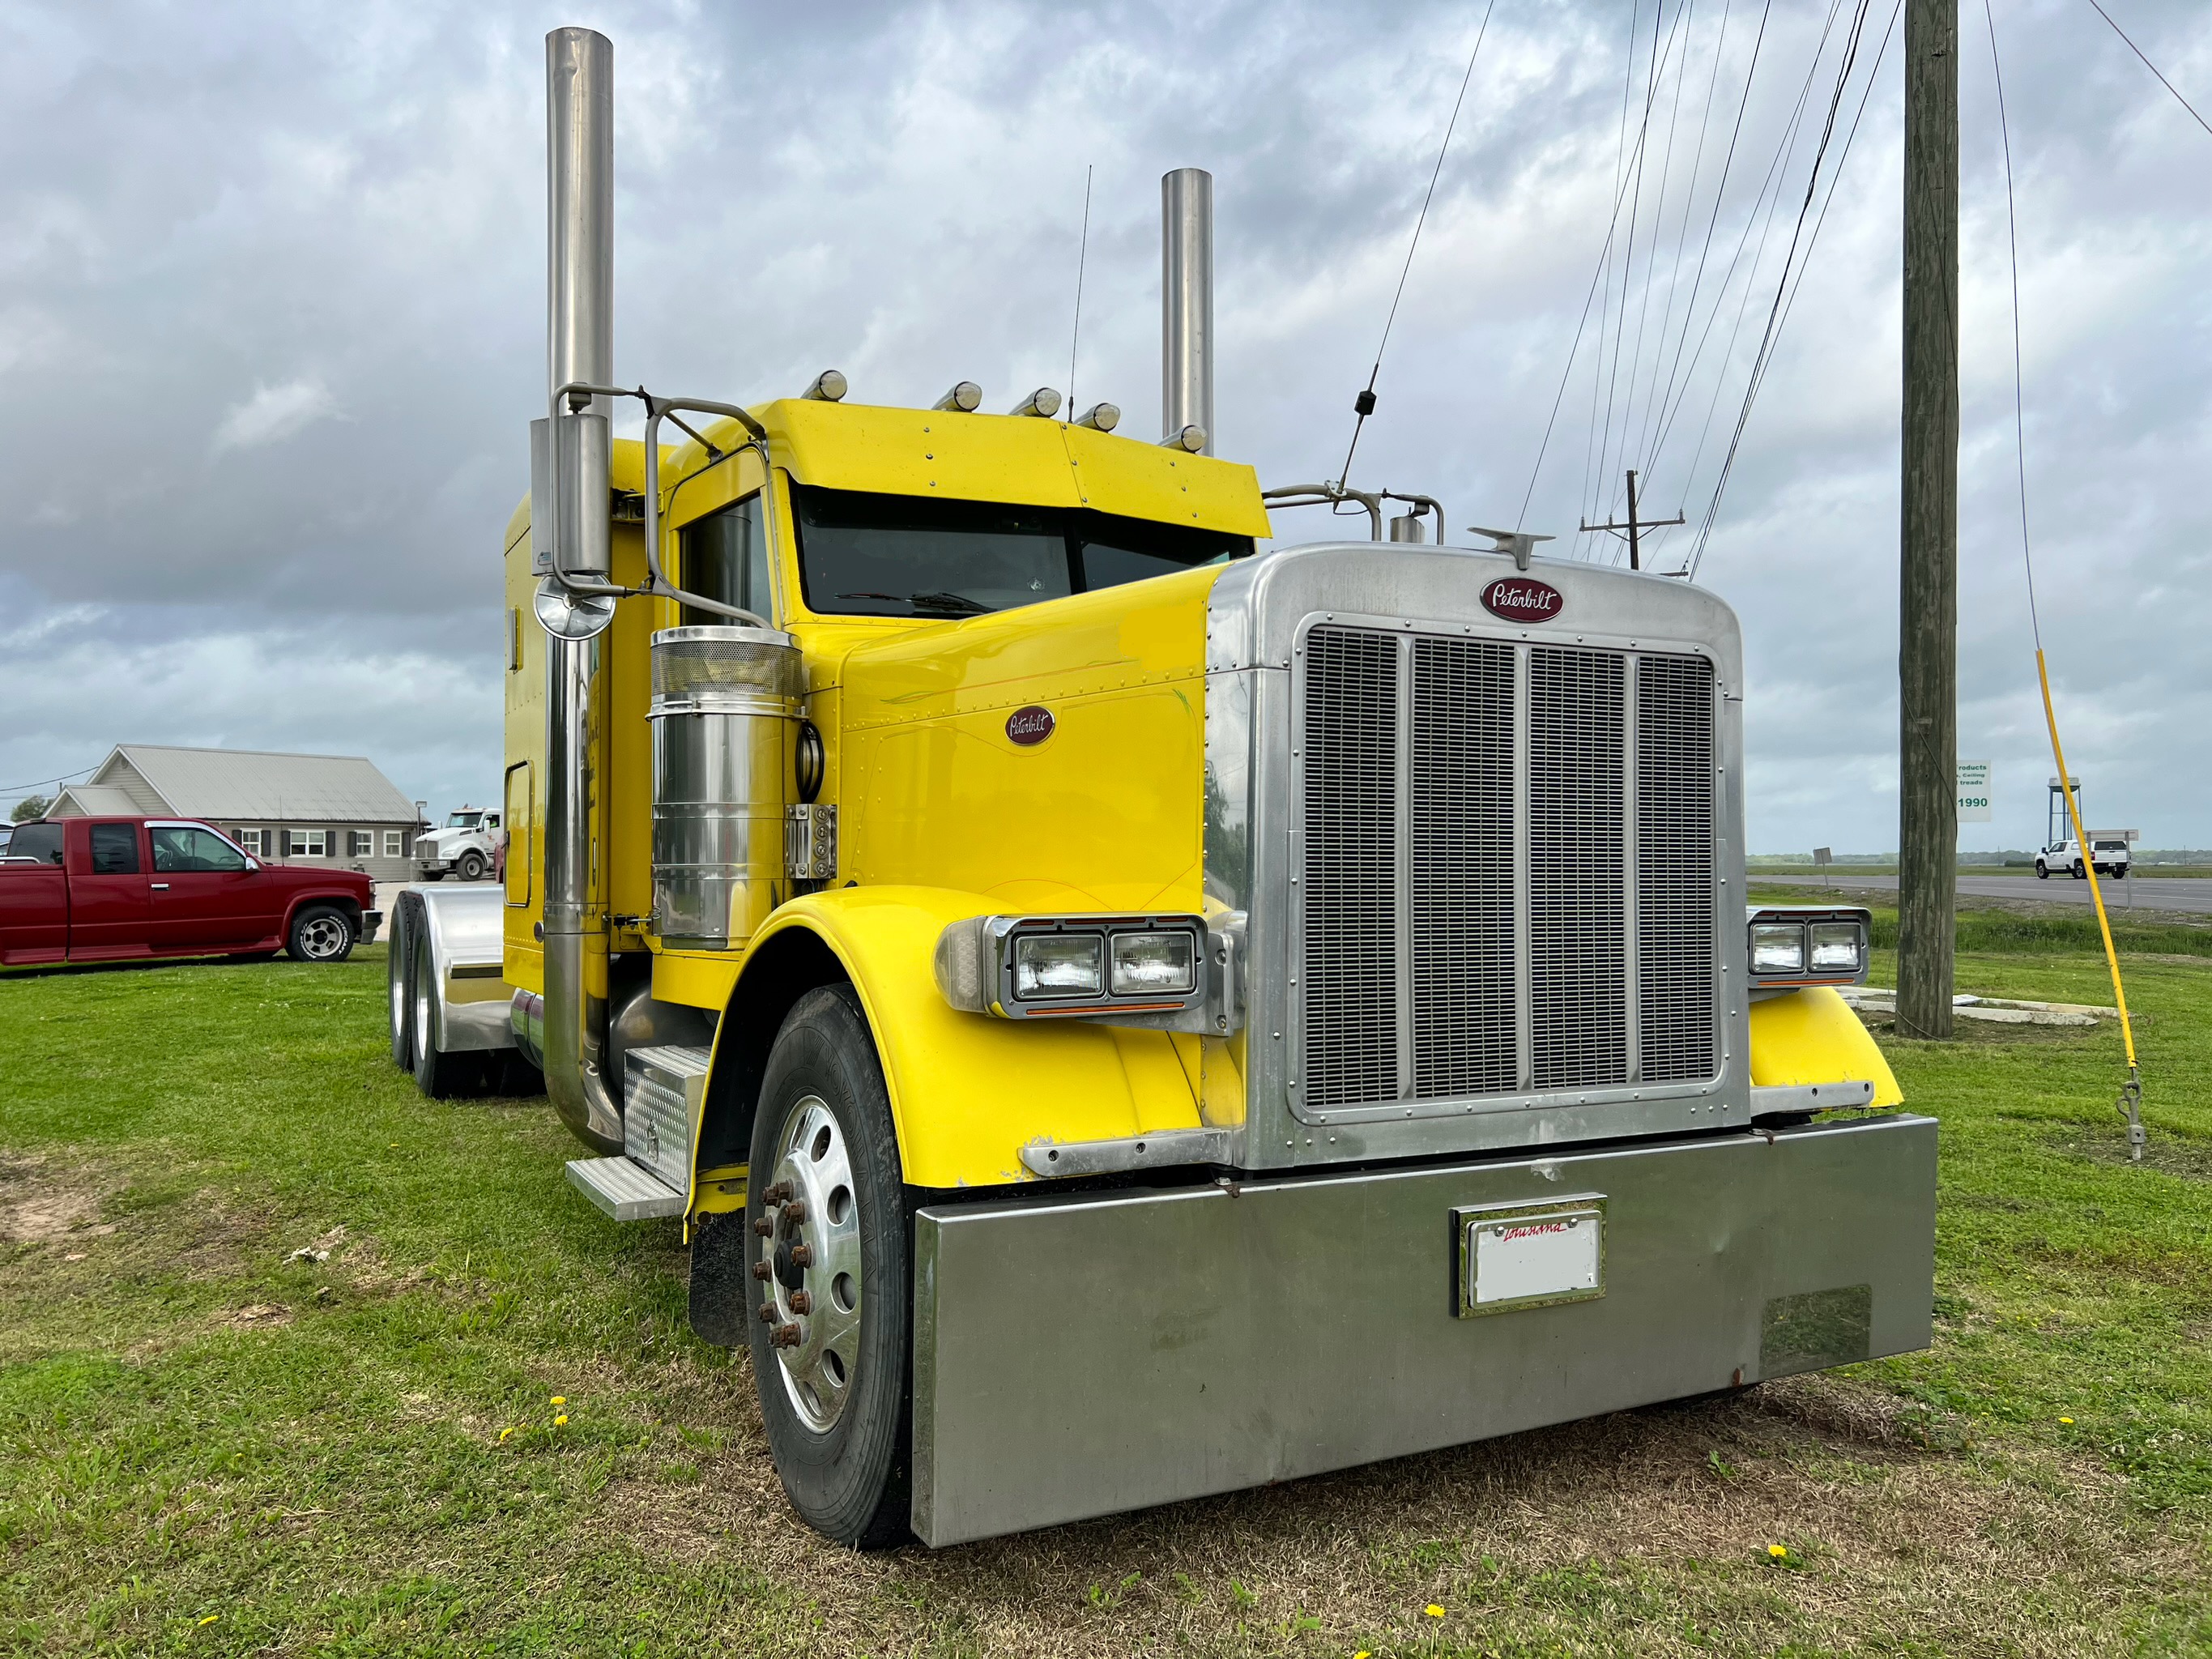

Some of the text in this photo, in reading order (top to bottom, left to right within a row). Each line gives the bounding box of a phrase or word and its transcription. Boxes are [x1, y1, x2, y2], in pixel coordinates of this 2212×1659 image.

[1492, 583, 1558, 610] Peterbilt
[1010, 714, 1049, 738] Peterbilt
[329, 915, 348, 954] MASTERCRAFT
[824, 1046, 877, 1284] YOKOHAMA
[1503, 1222, 1567, 1242] Louisiana
